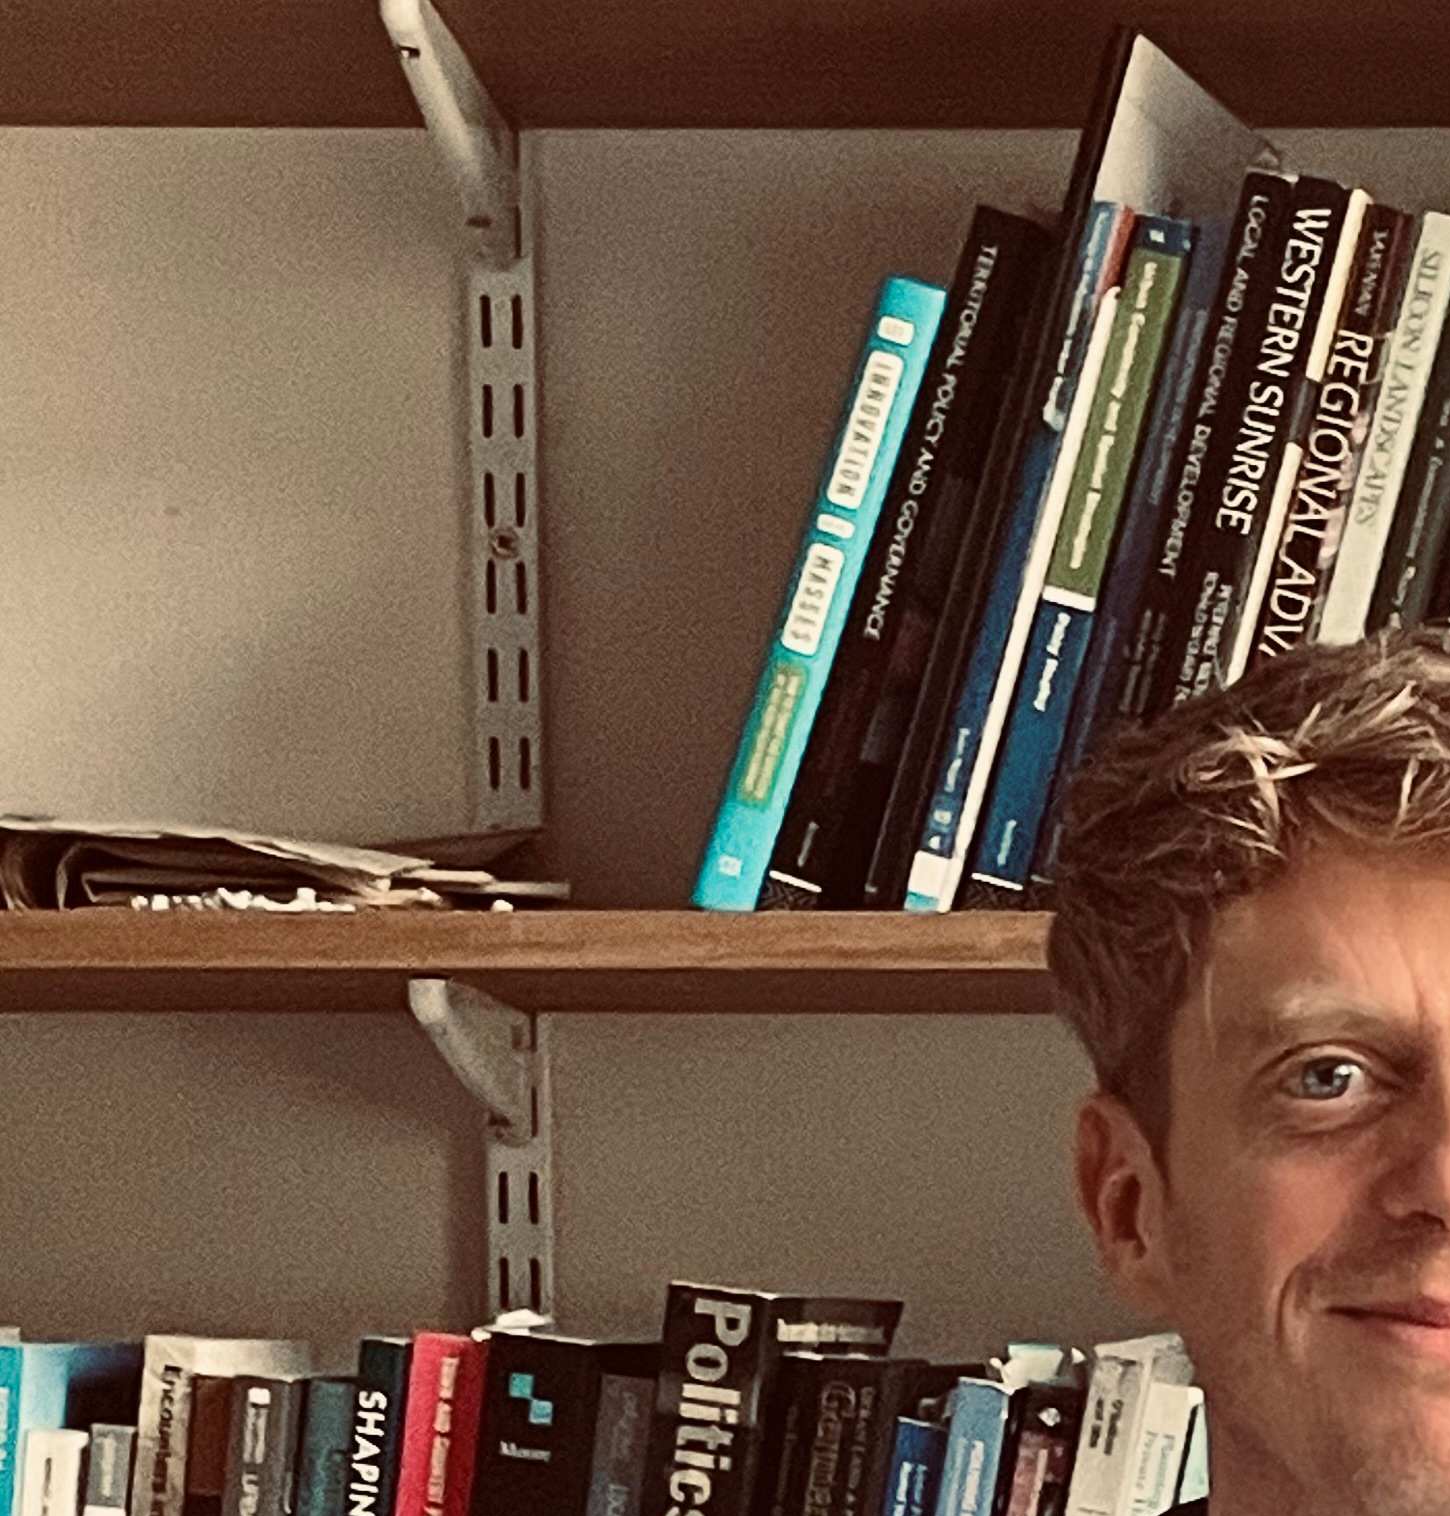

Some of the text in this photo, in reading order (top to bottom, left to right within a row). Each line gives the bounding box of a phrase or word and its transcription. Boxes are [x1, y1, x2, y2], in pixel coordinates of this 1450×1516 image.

[1226, 267, 1249, 312] AND
[1236, 194, 1269, 262] LOCAL
[1198, 315, 1238, 418] REGIONAL
[1401, 249, 1441, 352] SILICON
[837, 363, 891, 497] INNOVATION
[1215, 208, 1330, 535] WESTERN SUNRISE
[864, 247, 998, 639] TERRITORIAL POLICY AND GOVERNANCE
[1159, 423, 1212, 577] DEVELOPMENT
[1282, 329, 1374, 551] REGIONAL
[1356, 360, 1416, 525] LANDSCAPES
[791, 555, 833, 641] MASSES
[150, 1364, 182, 1495] Encounters
